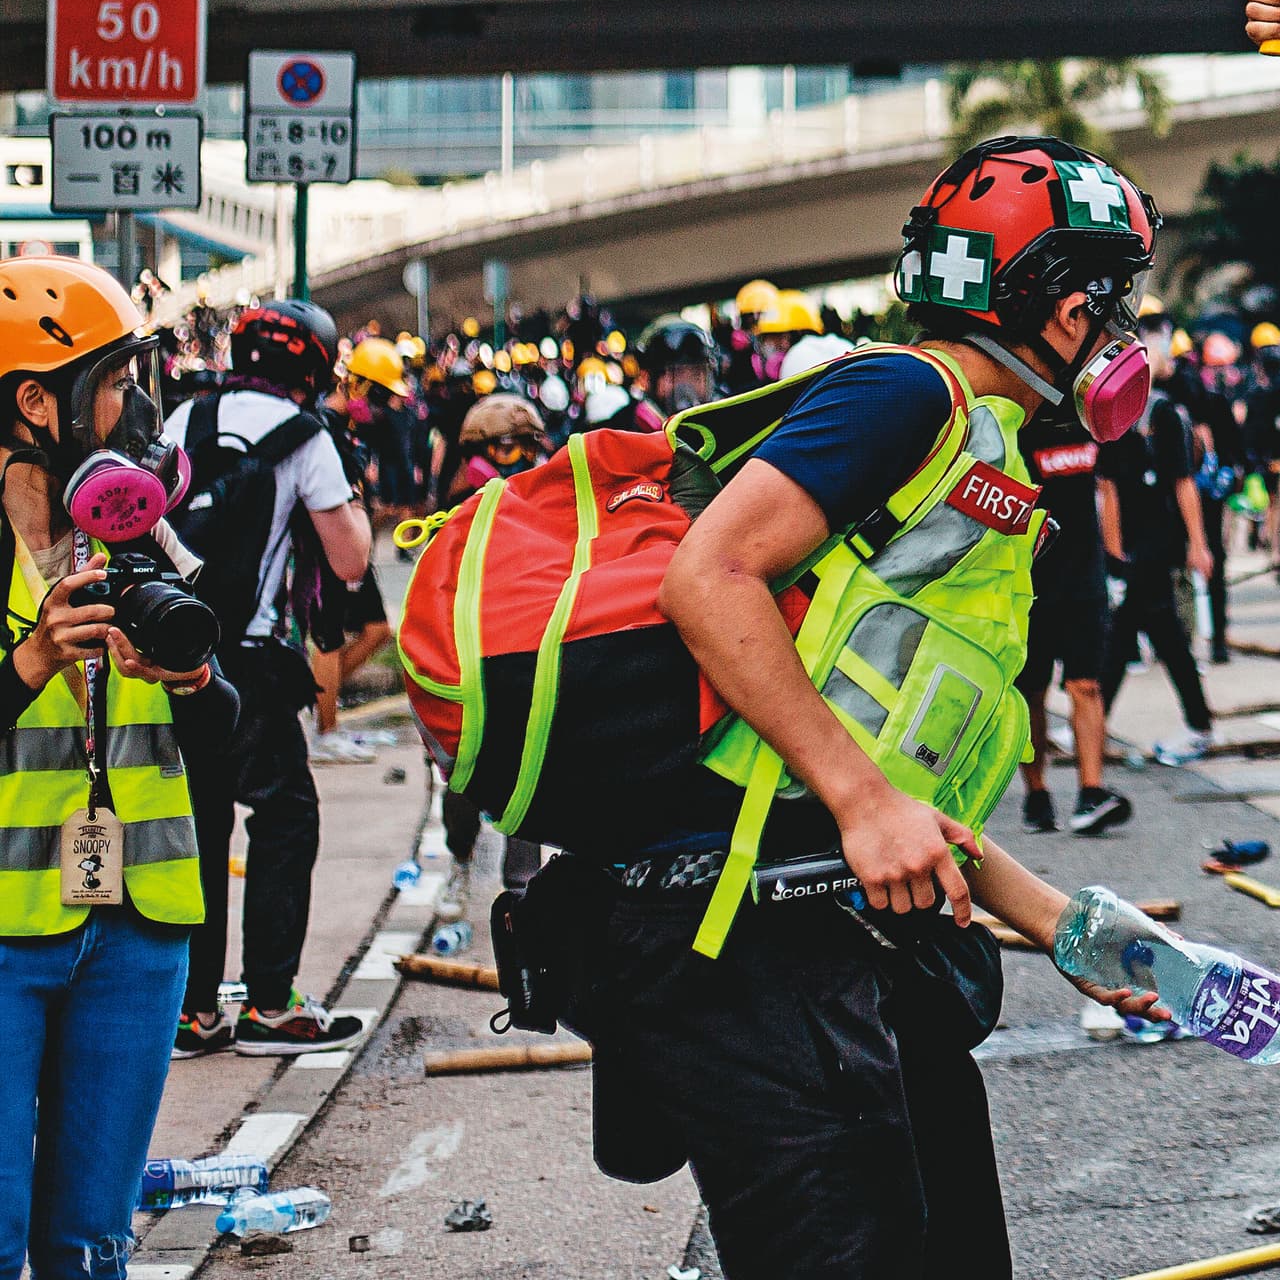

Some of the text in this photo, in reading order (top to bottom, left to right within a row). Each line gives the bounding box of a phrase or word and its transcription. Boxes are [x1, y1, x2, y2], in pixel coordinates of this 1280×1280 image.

[97, 2, 160, 41] 50
[69, 48, 183, 90] km/h
[82, 124, 171, 150] 100 m
[67, 161, 186, 196] 一百米
[961, 474, 1031, 526] FIRST
[73, 839, 111, 855] SNOOPY
[782, 877, 863, 900] COLD FIR
